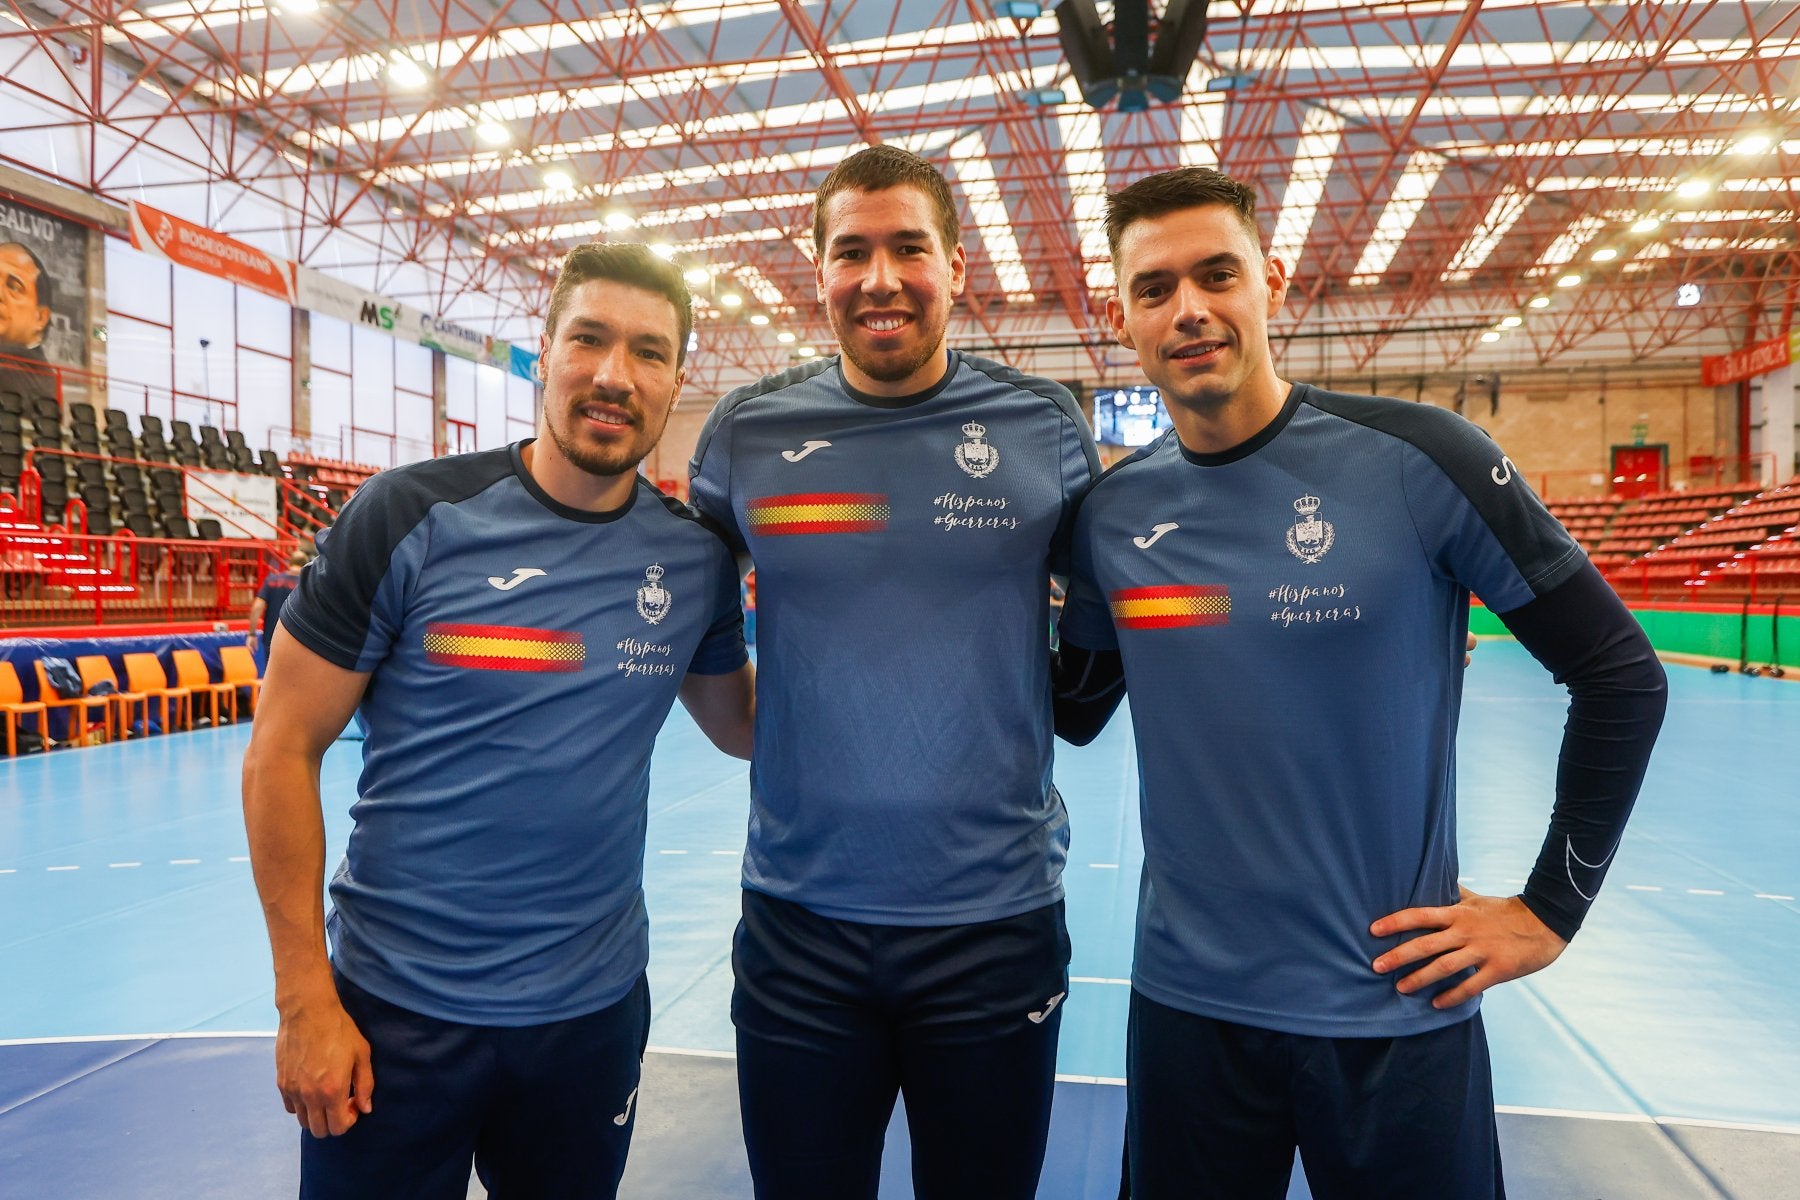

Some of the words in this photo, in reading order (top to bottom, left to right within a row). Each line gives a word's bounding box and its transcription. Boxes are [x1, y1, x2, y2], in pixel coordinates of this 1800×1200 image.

[933, 492, 1010, 513] #Hispanos
[933, 512, 1020, 532] #Guerreras
[1268, 583, 1350, 605] #Hispanos
[1270, 605, 1361, 628] #Guerreras
[616, 637, 673, 659] #Hispanos
[617, 658, 675, 678] #Guerreras
